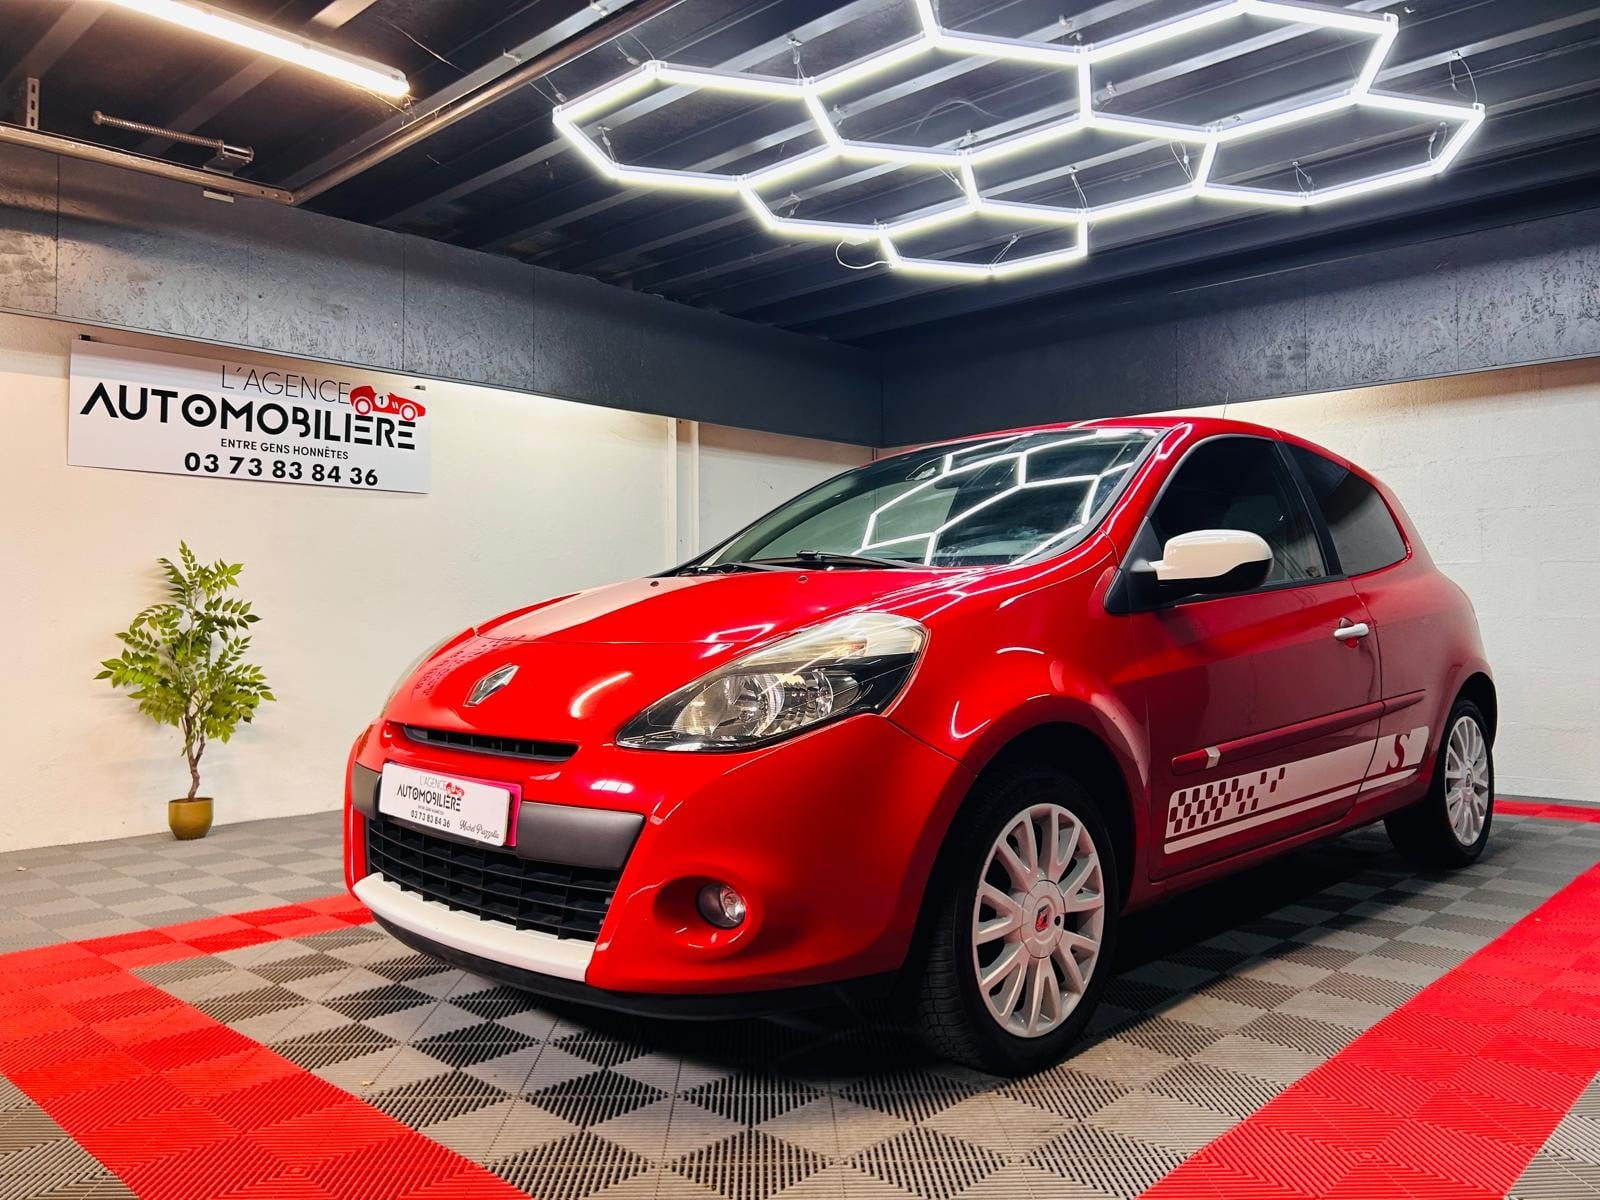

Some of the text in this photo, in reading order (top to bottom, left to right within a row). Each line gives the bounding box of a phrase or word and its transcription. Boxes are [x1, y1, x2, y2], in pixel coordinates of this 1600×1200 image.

[378, 395, 385, 406] 1
[220, 438, 349, 460] ENTRE GENS HONNÊTES
[184, 452, 379, 487] 03 73 83 84 36
